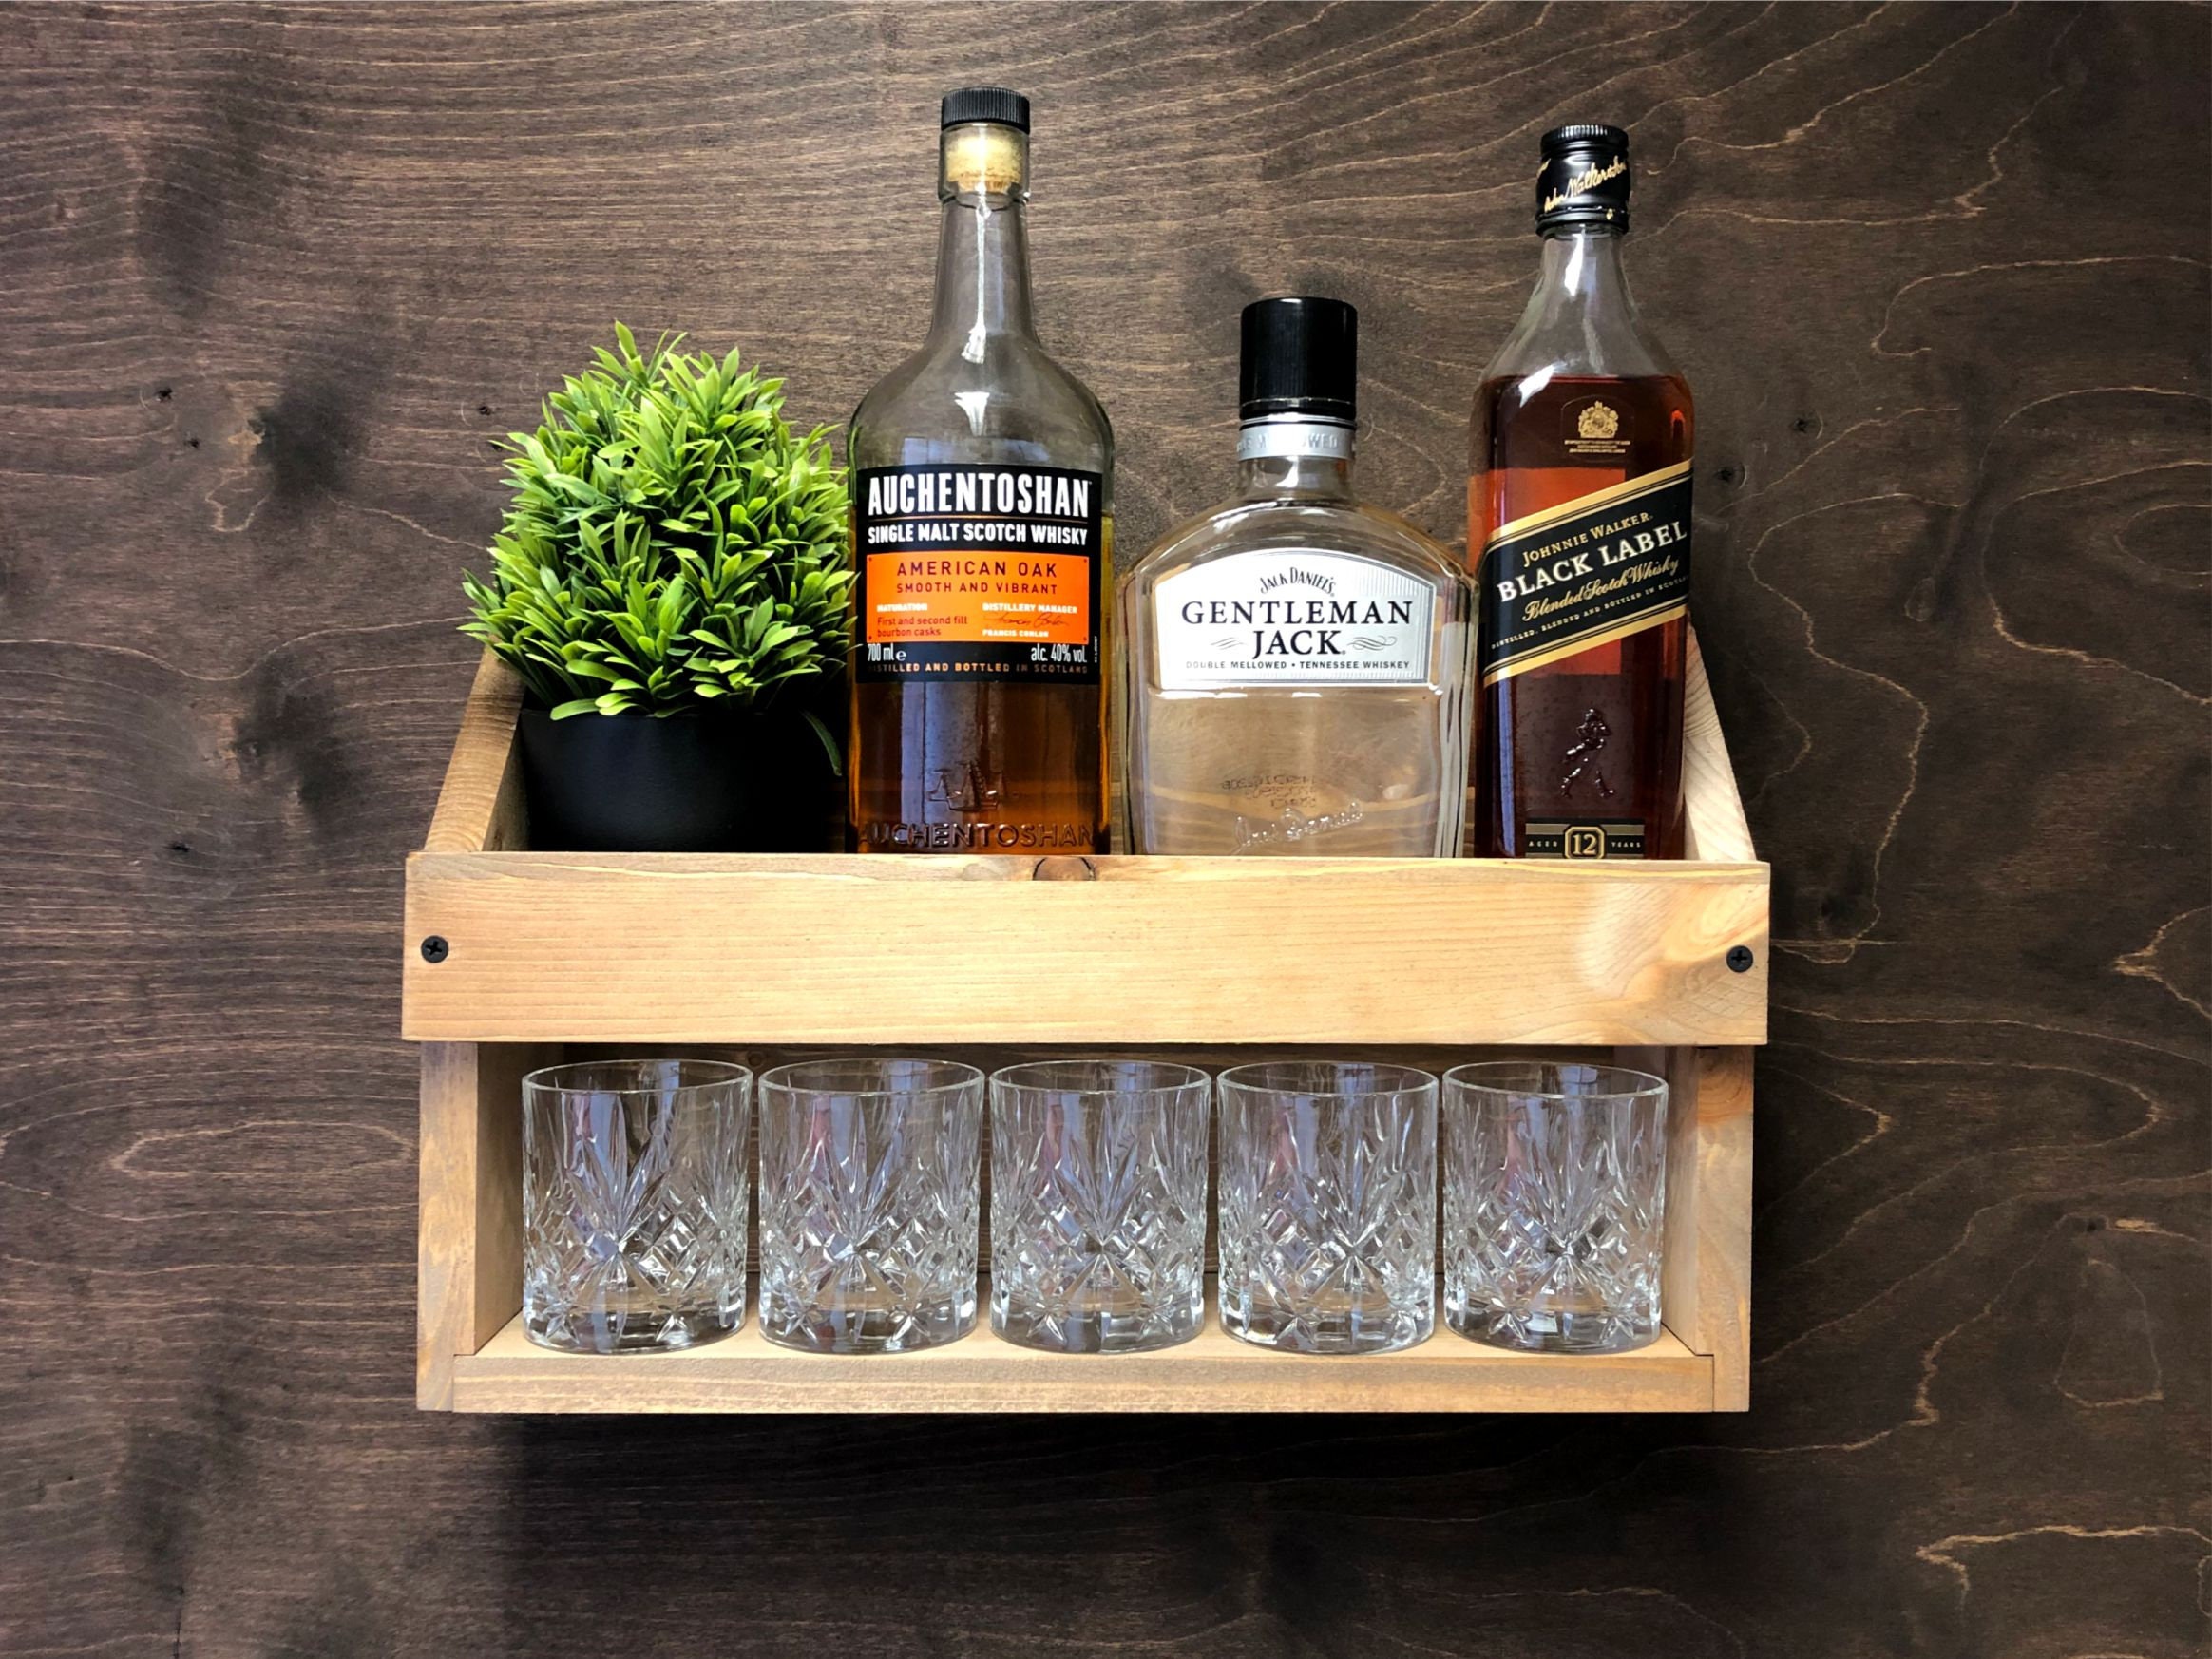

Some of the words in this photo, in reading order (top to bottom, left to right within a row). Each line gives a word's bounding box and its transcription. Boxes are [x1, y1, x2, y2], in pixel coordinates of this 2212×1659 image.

[868, 473, 1088, 517] AUCHENTOSHAN
[868, 524, 914, 544] SINGLE
[918, 524, 959, 542] MALT
[963, 524, 1026, 542] SCOTCH
[1031, 525, 1087, 545] WHISKY
[1522, 533, 1588, 567] JOHNNIE
[1590, 512, 1649, 539] WALKER
[897, 561, 1006, 576] AMERICAN
[1018, 563, 1057, 578] OAK
[1497, 552, 1593, 602] BLACK
[1598, 521, 1687, 566] LABEL
[896, 582, 951, 593] SMOOTH
[959, 582, 988, 593] AND
[996, 582, 1057, 594] VIBRANT
[1522, 585, 1584, 621] Blended
[1583, 570, 1628, 600] Scotch
[1627, 555, 1679, 583] Whisky
[982, 602, 1036, 612] DISTILLERY
[1182, 601, 1413, 624] GENTLEMAN
[1541, 614, 1580, 631] BLENDED
[1583, 607, 1601, 617] AND
[1604, 592, 1642, 609] BOTTLED
[877, 617, 896, 625] First
[898, 617, 914, 625] and
[917, 616, 951, 624] second
[954, 616, 967, 624] fill
[877, 628, 912, 638] bourbon
[914, 627, 942, 637] casks
[868, 643, 881, 661] 700
[883, 643, 894, 660] ml
[1051, 644, 1071, 662] 40%
[1251, 630, 1341, 659] JACK
[925, 663, 949, 672] AND
[955, 662, 1010, 672] BOTTLED
[1573, 834, 1597, 855] 12
